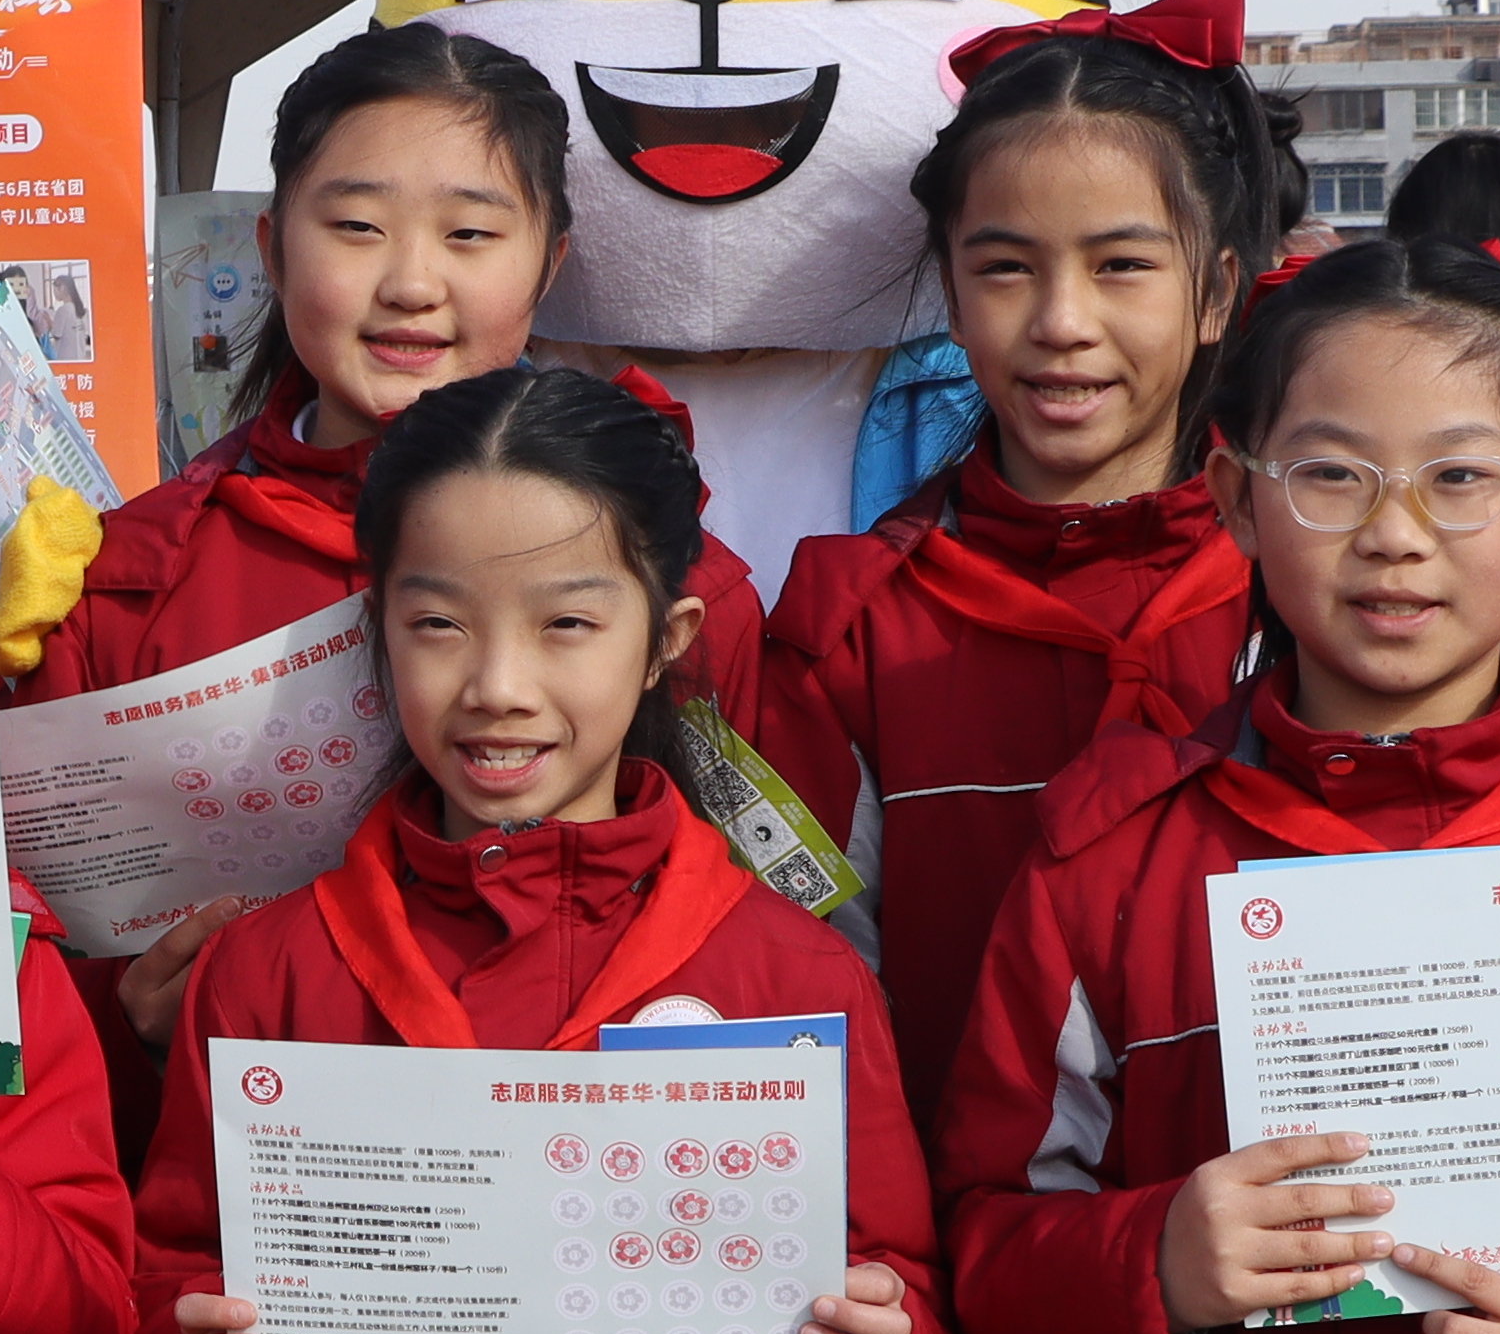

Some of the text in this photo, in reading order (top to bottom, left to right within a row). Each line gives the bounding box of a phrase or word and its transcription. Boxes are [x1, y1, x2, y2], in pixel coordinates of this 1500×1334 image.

[104, 624, 366, 727] 志愿服务嘉年华·集章活动规则
[491, 1079, 807, 1105] 志愿服务嘉年华·集章活动规则
